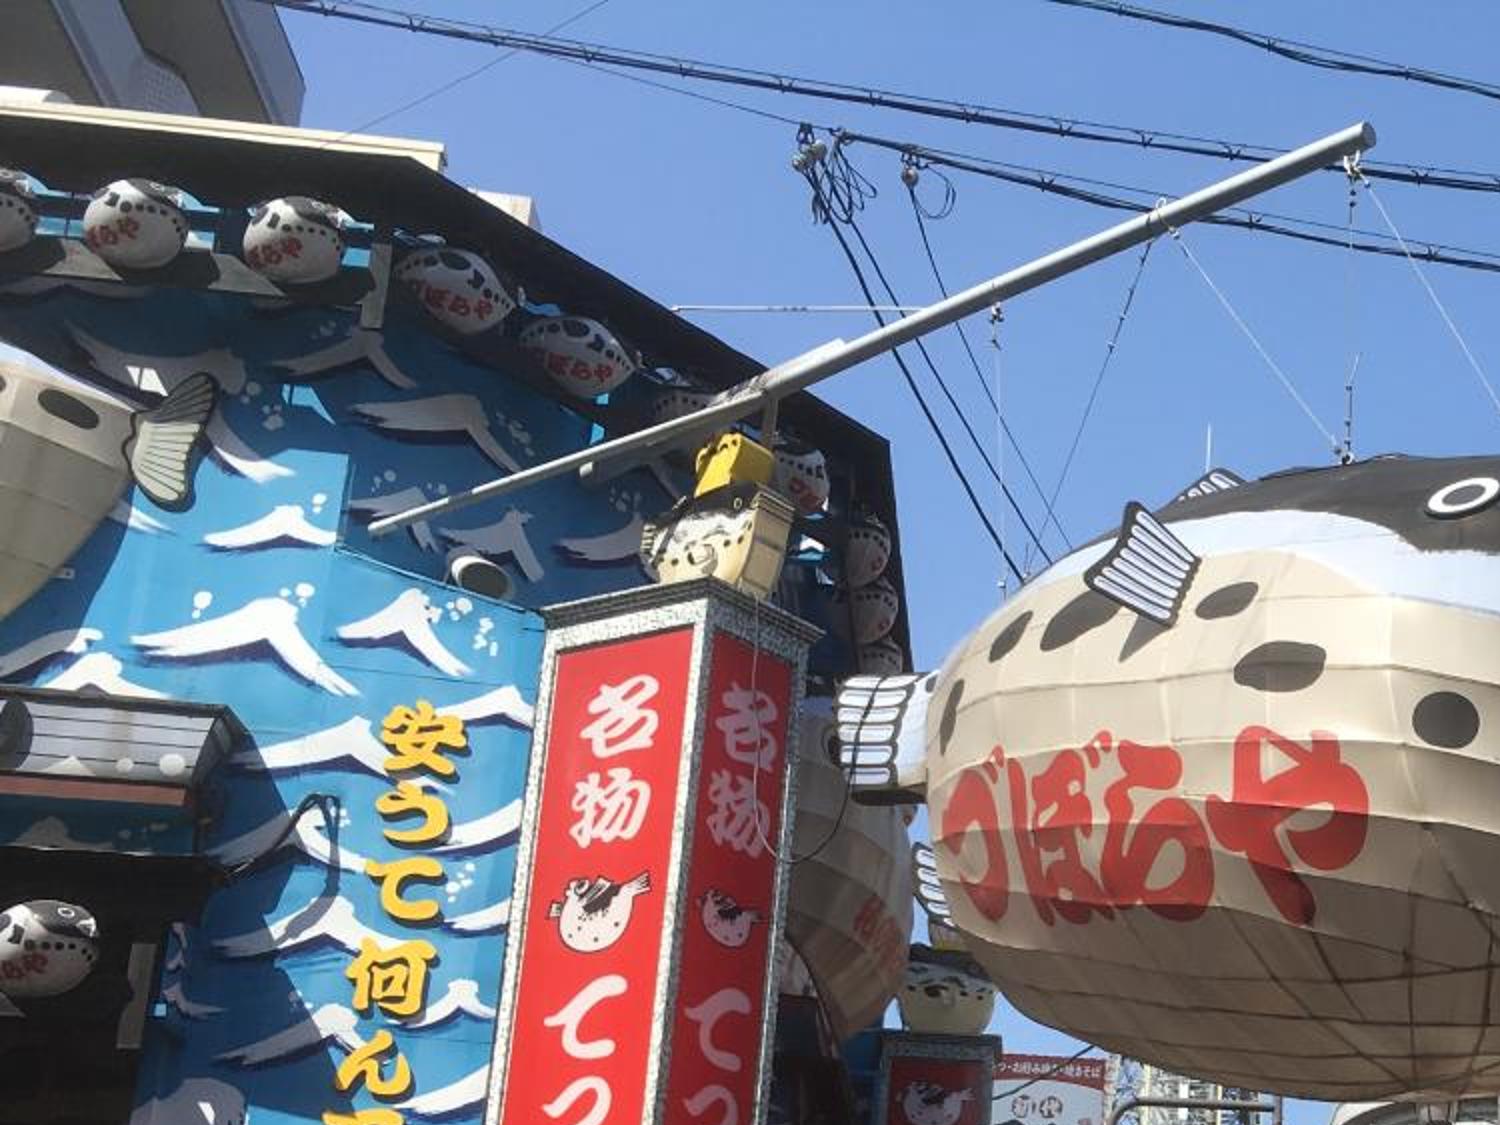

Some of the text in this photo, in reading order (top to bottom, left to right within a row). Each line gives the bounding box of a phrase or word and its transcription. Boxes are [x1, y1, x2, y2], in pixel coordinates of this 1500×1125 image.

[566, 674, 661, 850] 名物
[937, 725, 1370, 927] づぼらや
